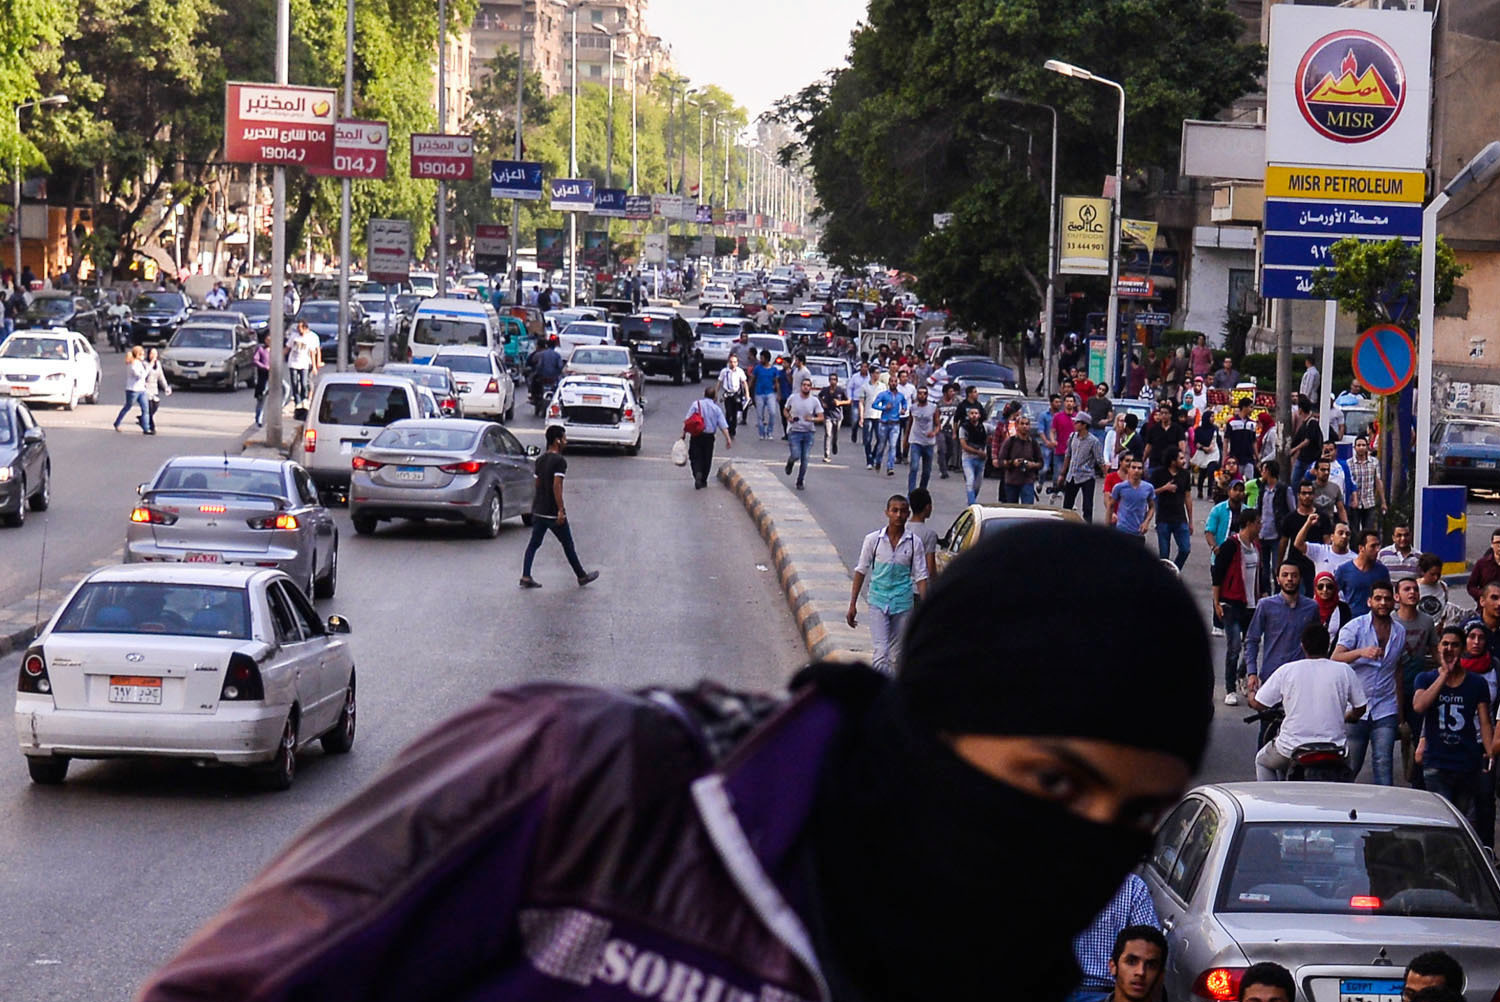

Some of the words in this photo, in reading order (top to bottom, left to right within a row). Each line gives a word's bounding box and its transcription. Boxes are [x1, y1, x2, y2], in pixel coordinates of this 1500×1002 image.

[246, 95, 305, 114] المختبر
[1327, 111, 1375, 128] MISR
[307, 130, 326, 141] 104
[335, 127, 362, 140] المخ
[261, 146, 297, 160] 19014
[334, 156, 364, 172] 014
[418, 162, 456, 174] 19014
[1289, 174, 1321, 192] MISR
[1324, 175, 1403, 195] PETROLEUM
[1299, 208, 1346, 226] الأورمان
[1349, 209, 1388, 225] محطة
[1438, 703, 1465, 731] 15
[1346, 982, 1373, 991] EGYPT
